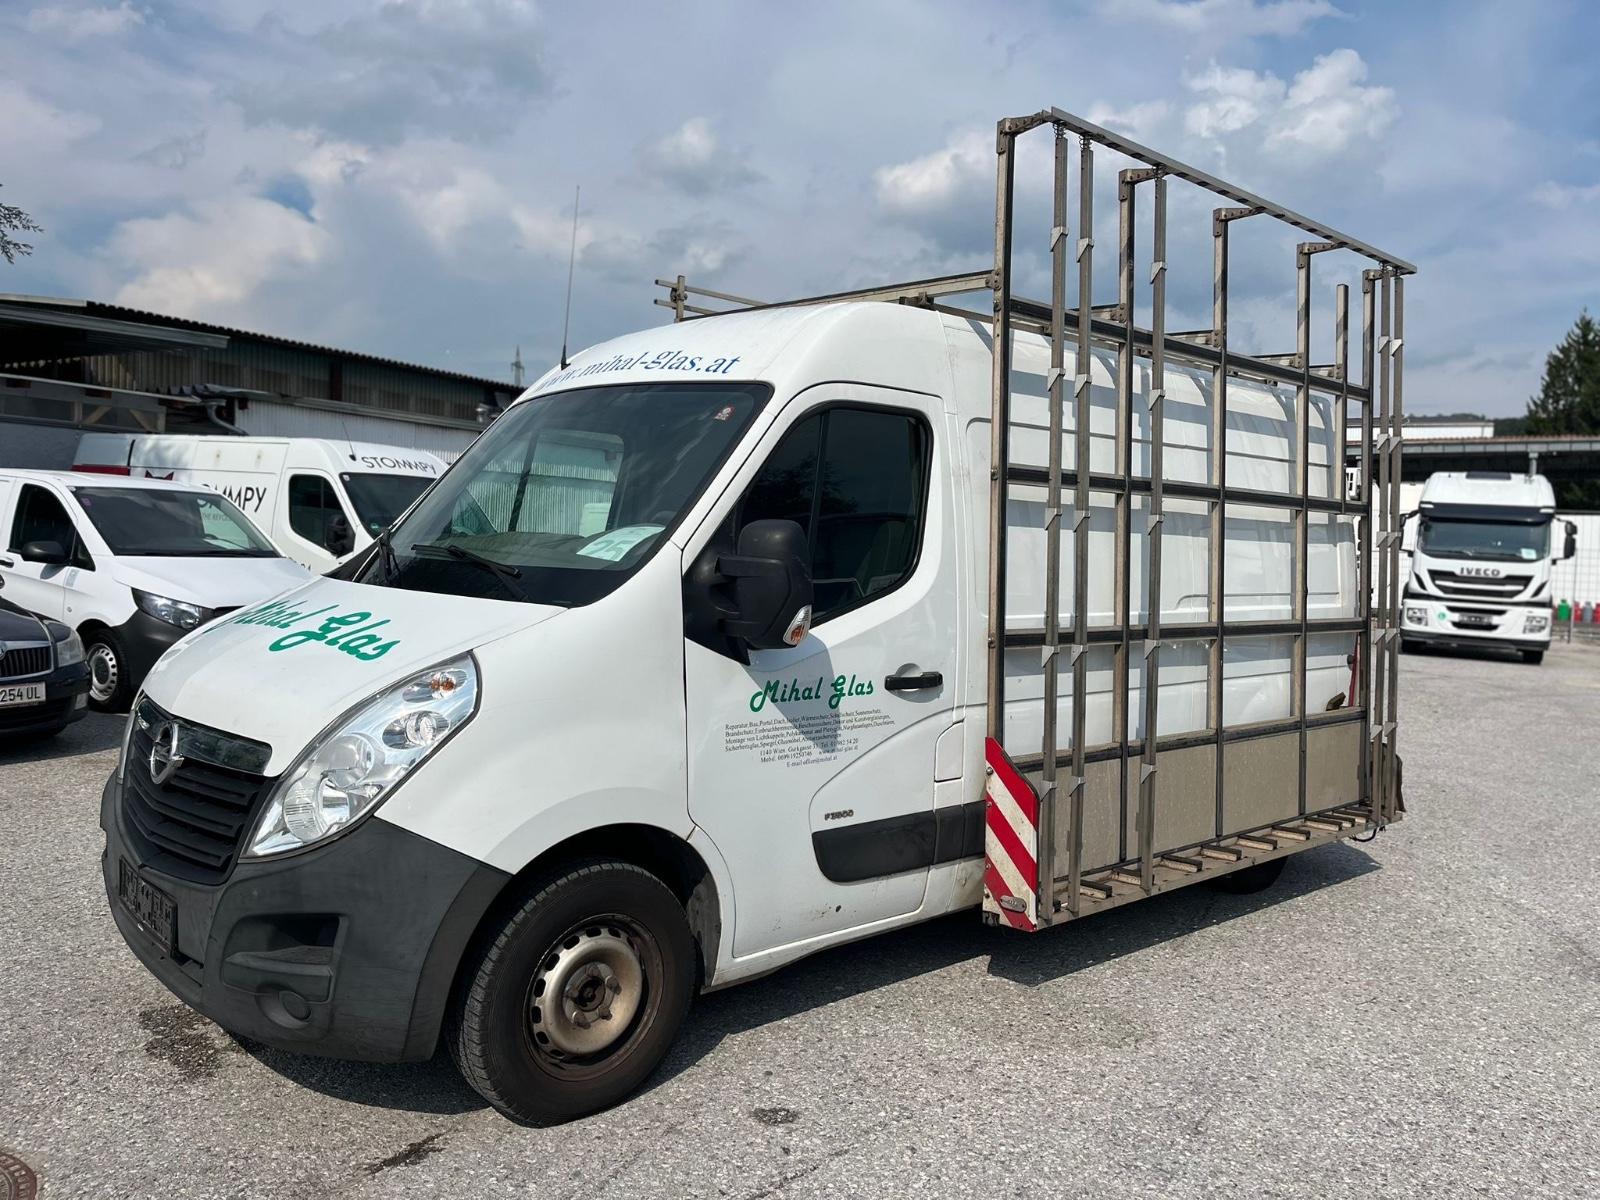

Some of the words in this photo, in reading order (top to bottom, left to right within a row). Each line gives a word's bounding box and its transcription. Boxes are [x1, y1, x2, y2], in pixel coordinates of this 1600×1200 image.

[361, 457, 437, 475] STOMMPY
[1460, 567, 1501, 577] IVECO
[268, 612, 401, 661] Glas
[0, 688, 23, 702] 254
[26, 686, 40, 700] UL
[750, 677, 823, 712] Mihal
[828, 674, 874, 710] Glas
